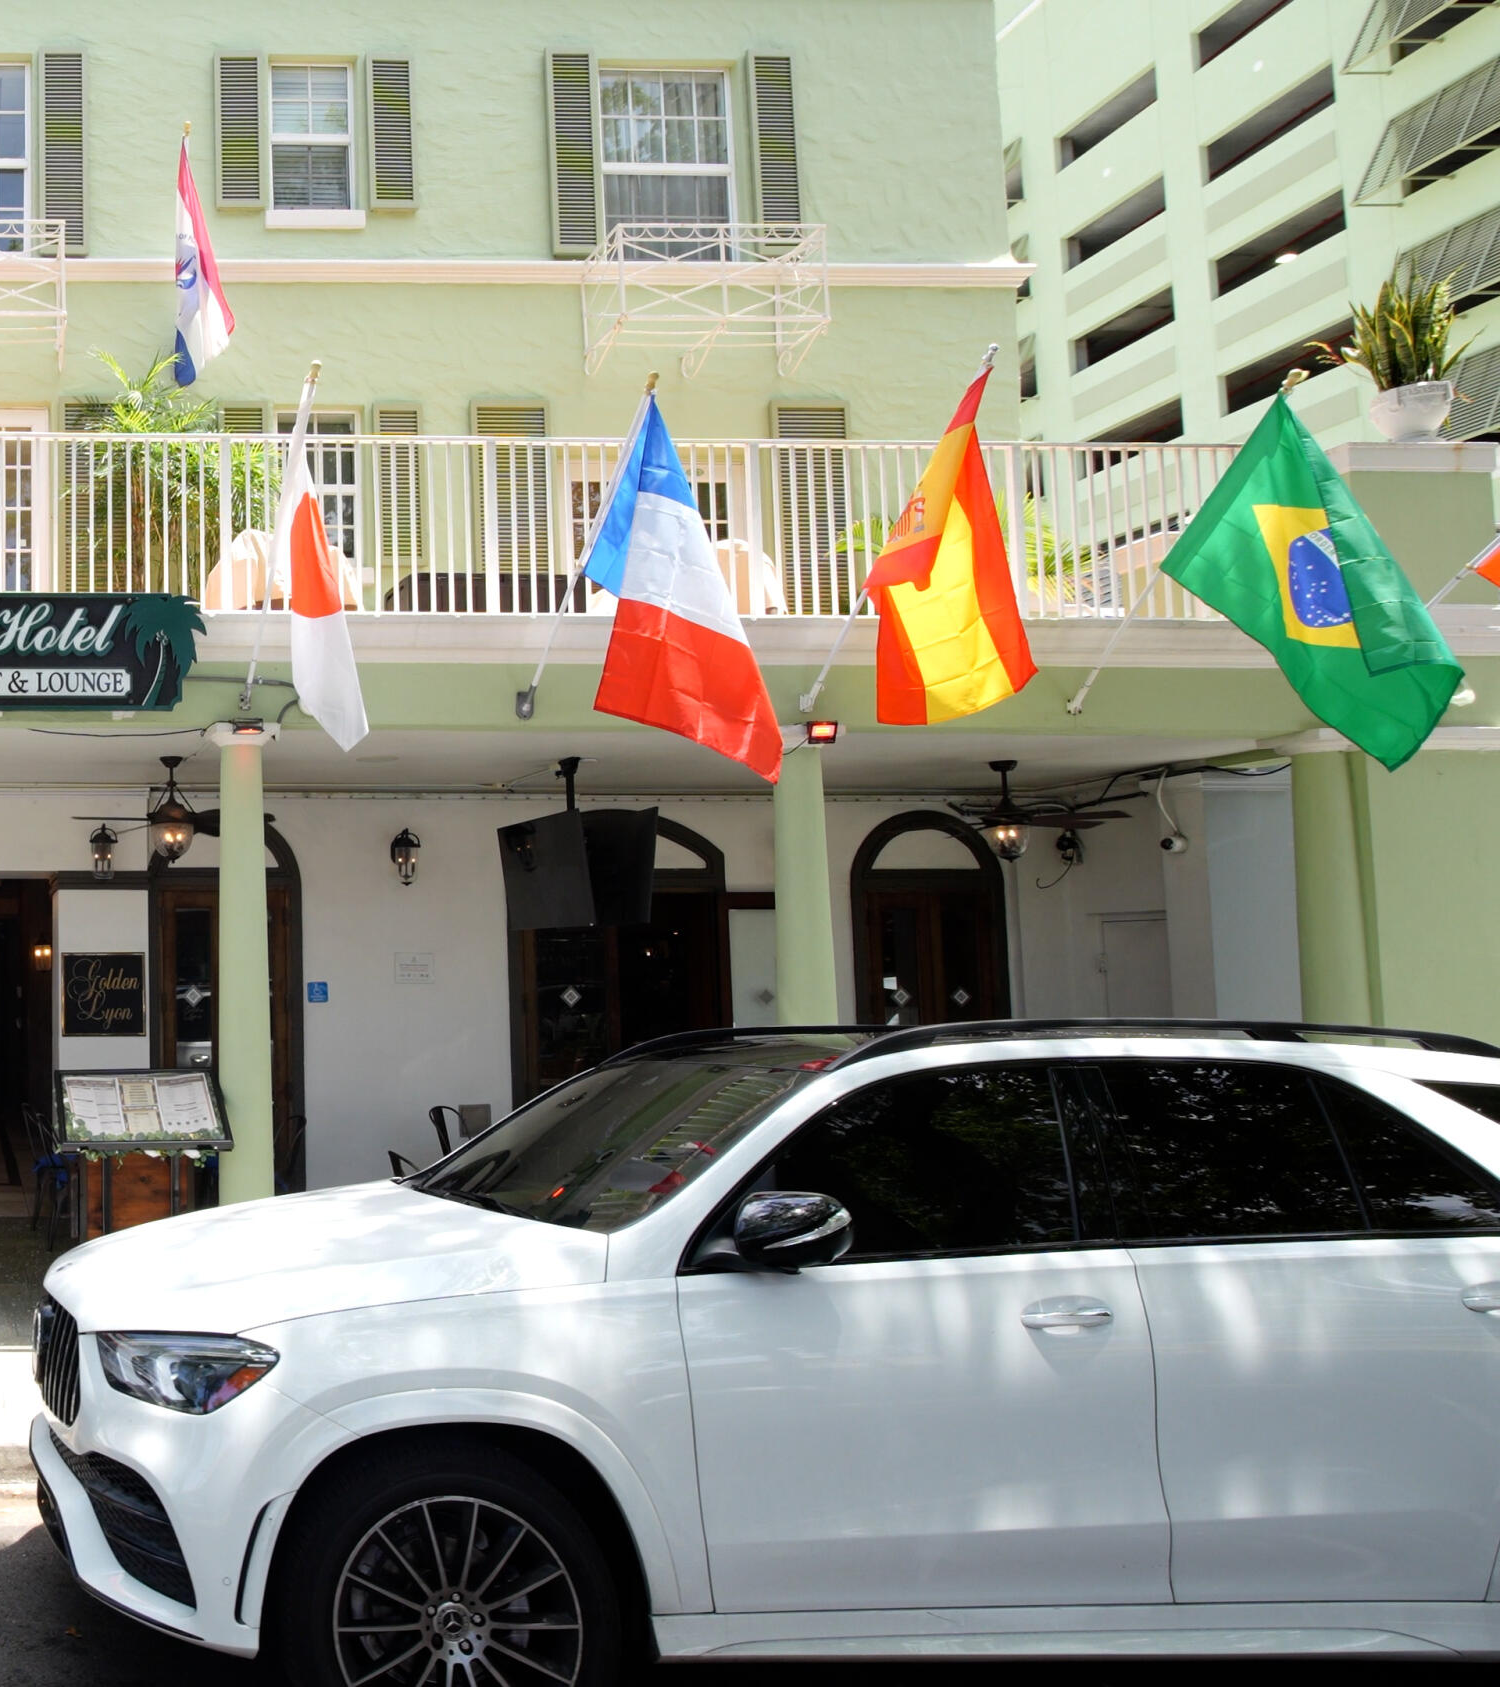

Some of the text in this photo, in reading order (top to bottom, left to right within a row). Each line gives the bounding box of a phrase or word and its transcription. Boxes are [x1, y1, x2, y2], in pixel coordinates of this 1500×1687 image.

[7, 670, 29, 693] &
[35, 671, 125, 693] LOUNGE
[67, 958, 140, 1001] Golden
[77, 990, 133, 1030] Lyon
